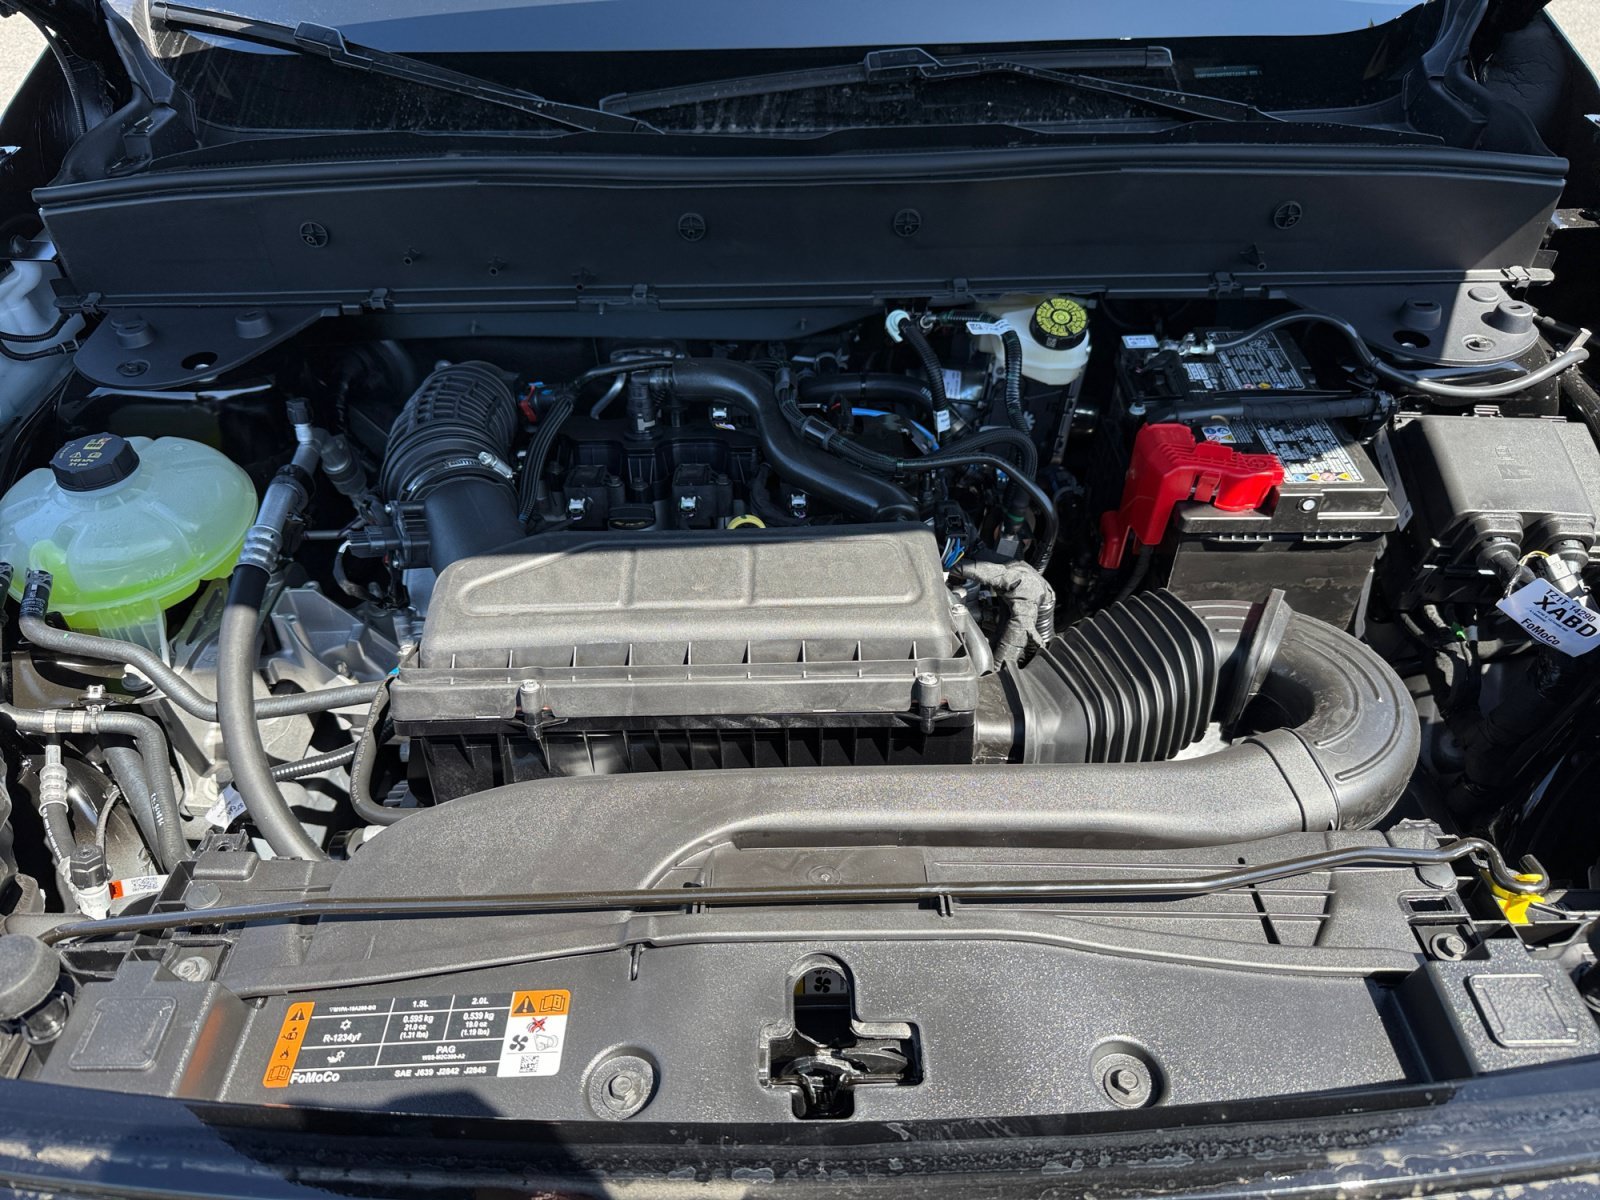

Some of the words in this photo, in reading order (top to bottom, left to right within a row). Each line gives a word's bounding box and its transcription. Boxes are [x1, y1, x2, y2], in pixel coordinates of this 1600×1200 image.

[1546, 588, 1569, 605] TZ1T
[1569, 605, 1596, 622] 14290
[1533, 596, 1598, 637] XABD
[1521, 618, 1560, 646] FoMoCo
[412, 1000, 428, 1008] 1.5L
[472, 997, 489, 1005] 2.0L
[424, 1014, 434, 1024] kg
[463, 1012, 484, 1020] 0.539
[484, 1012, 494, 1021] kg
[477, 1028, 490, 1036] lbs)
[323, 1032, 362, 1043] R-1234yf
[290, 1071, 340, 1084] FoMoCo
[394, 1070, 412, 1078] SAE
